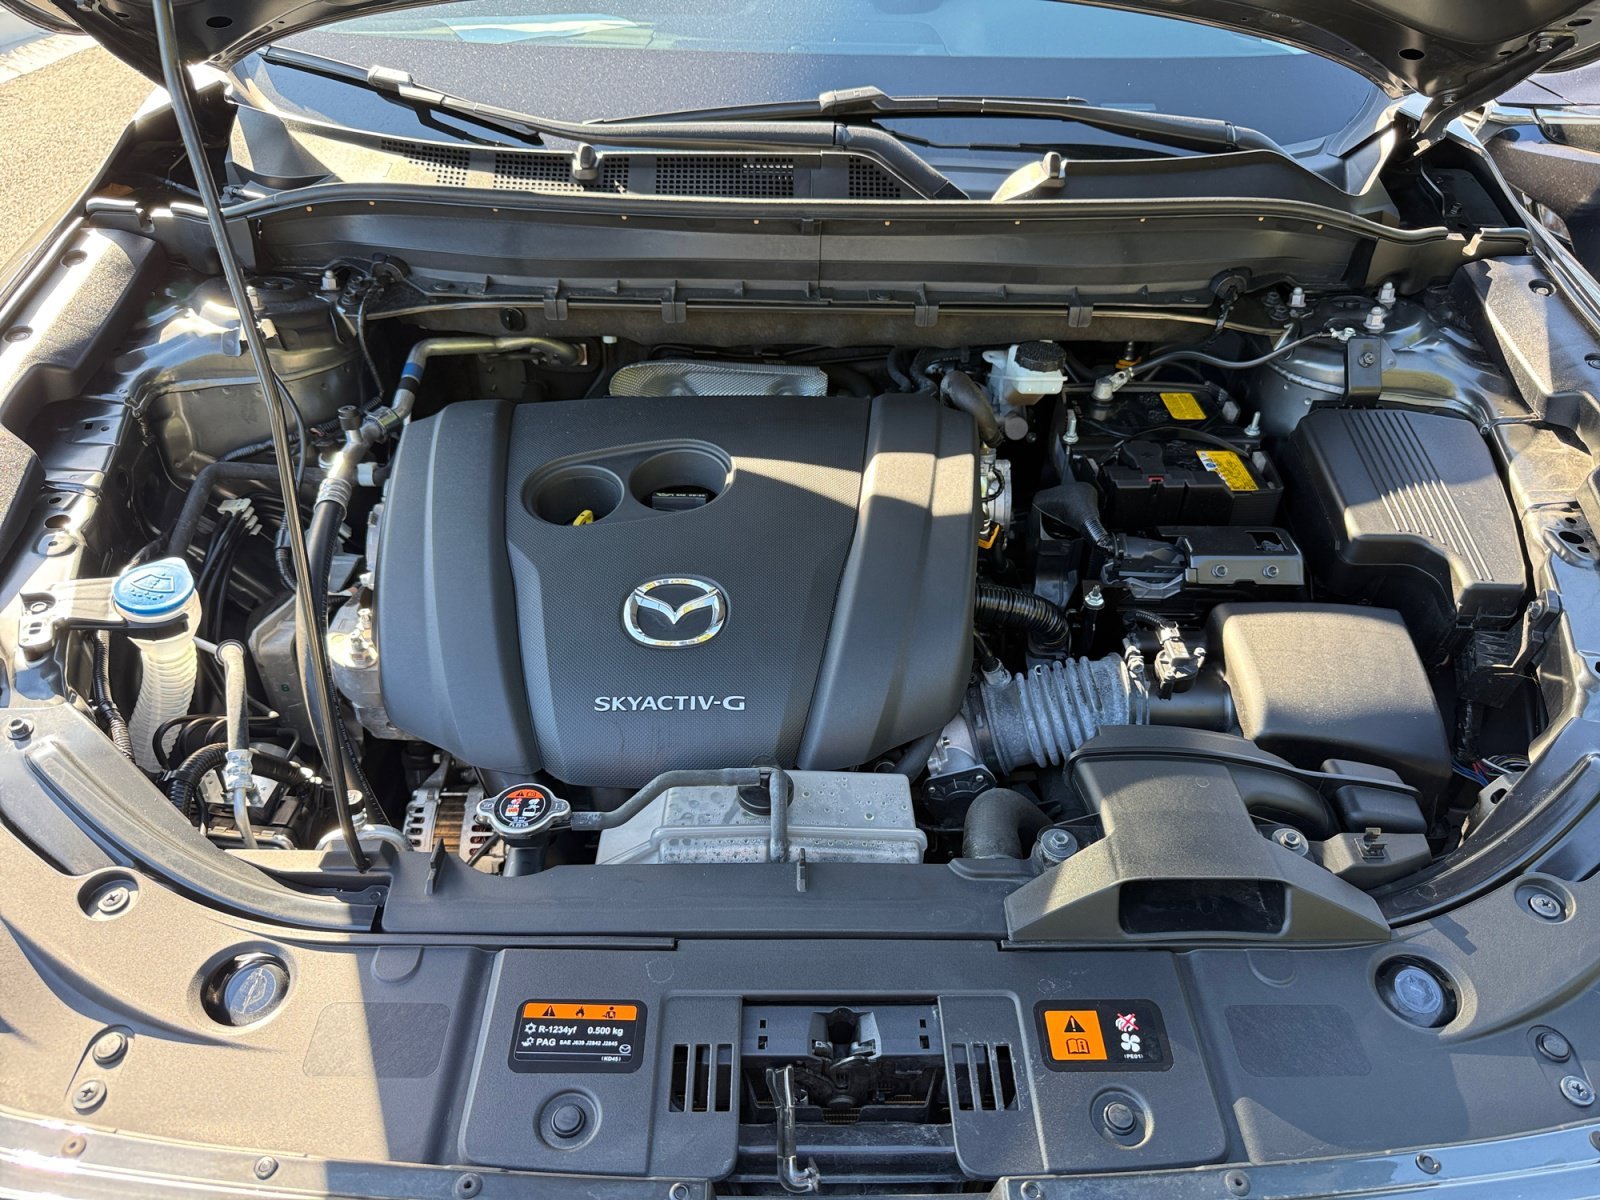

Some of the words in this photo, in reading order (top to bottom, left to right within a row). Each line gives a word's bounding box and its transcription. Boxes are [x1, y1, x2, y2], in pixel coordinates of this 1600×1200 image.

[594, 695, 746, 712] SKYACTIV-G
[538, 1025, 577, 1036] R-1234yf
[587, 1026, 611, 1035] 0.500
[612, 1026, 624, 1036] kg
[536, 1038, 556, 1046] PAG
